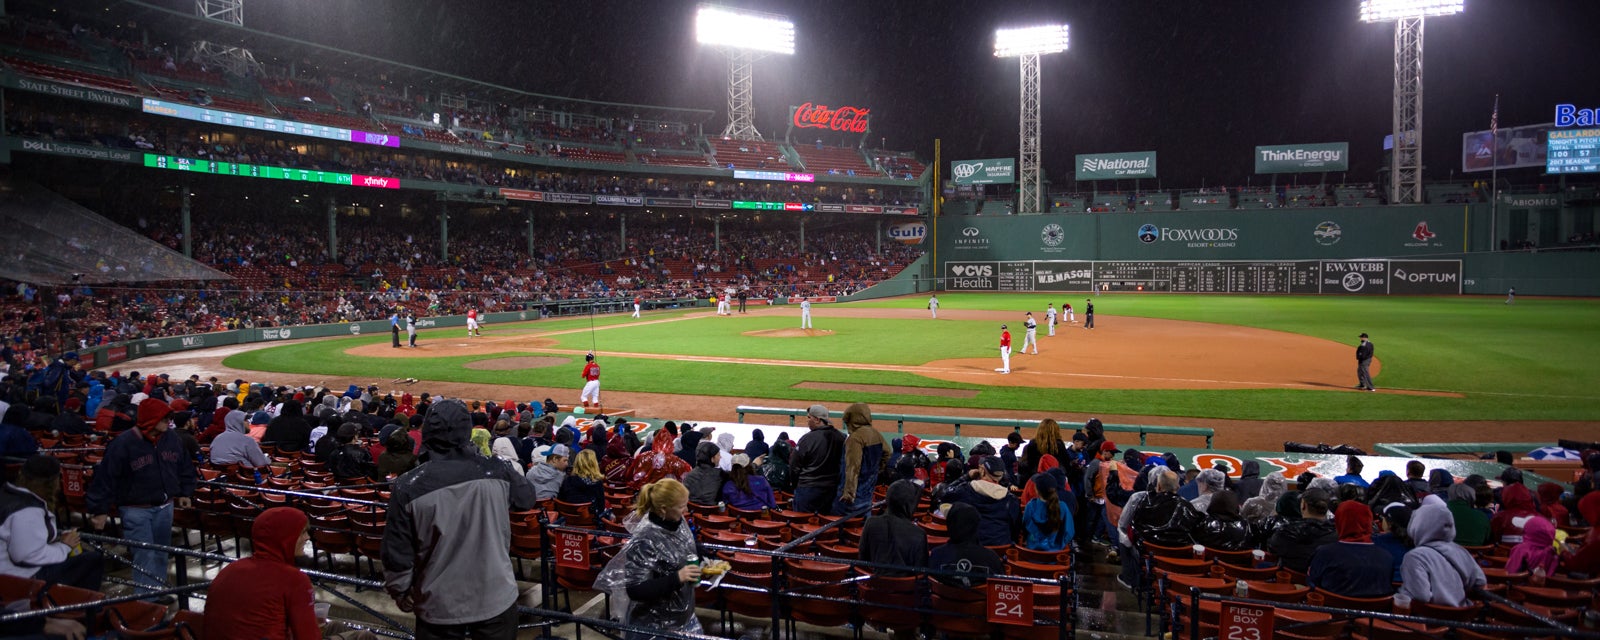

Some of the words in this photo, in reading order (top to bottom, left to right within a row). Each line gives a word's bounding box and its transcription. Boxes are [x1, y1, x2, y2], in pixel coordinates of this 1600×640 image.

[20, 80, 49, 92] STATE
[51, 85, 84, 98] STREET
[88, 91, 130, 106] PAVILION
[794, 102, 870, 133] Coca-Cola
[1555, 104, 1600, 127] Ba
[1549, 129, 1600, 139] GALLARDO
[23, 140, 53, 152] DELL
[53, 143, 109, 159] Technologies
[109, 151, 131, 160] Level
[1261, 149, 1341, 162] ThinkEnergy
[1098, 157, 1150, 170] National
[364, 177, 389, 188] xfinity
[889, 226, 924, 237] Gulf
[1162, 228, 1238, 241] FOXWOODS
[965, 265, 992, 276] CVS
[1349, 263, 1385, 272] WEBB
[953, 277, 992, 288] Health
[1408, 273, 1456, 283] OPTUM
[68, 481, 80, 491] 28
[561, 533, 583, 541] FIELD
[563, 548, 583, 562] 25
[994, 584, 1024, 593] FIELD
[998, 592, 1019, 600] BOX
[994, 602, 1024, 617] 24
[1229, 606, 1264, 617] FIELD
[1233, 615, 1258, 624] BOX
[1228, 625, 1261, 640] 23
